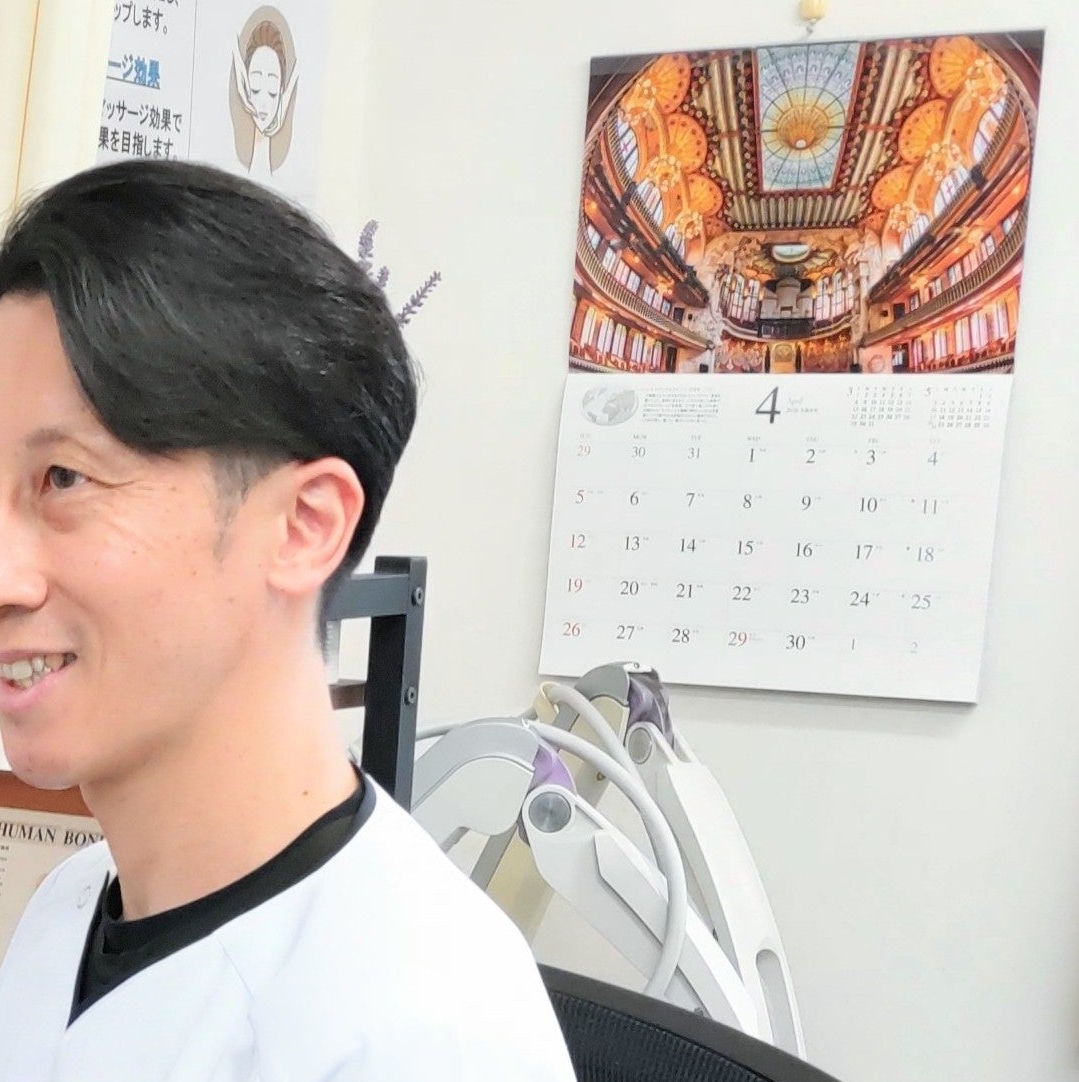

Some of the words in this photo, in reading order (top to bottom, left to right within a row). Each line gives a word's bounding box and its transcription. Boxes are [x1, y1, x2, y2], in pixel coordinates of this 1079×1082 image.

[755, 386, 781, 425] 4
[576, 444, 592, 458] 29
[631, 444, 646, 459] 30
[687, 446, 701, 460] 31
[806, 449, 815, 464] 2
[866, 450, 875, 465] 3
[927, 451, 938, 466] 4
[576, 490, 585, 504] 5
[630, 492, 638, 505] 6
[686, 493, 695, 507] 7
[743, 494, 752, 508] 8
[802, 496, 811, 510] 9
[860, 497, 877, 512] 10
[923, 499, 937, 514] 11
[571, 533, 586, 549] 12
[625, 536, 642, 551] 13
[681, 538, 696, 552] 14
[738, 541, 753, 555] 15
[797, 543, 812, 557] 16
[856, 545, 873, 559] 17
[917, 547, 934, 562] 18
[568, 578, 582, 593] 19
[621, 581, 639, 595] 20
[676, 583, 692, 598] 21
[732, 586, 751, 601] 22
[791, 588, 809, 604] 23
[850, 591, 869, 607] 24
[911, 594, 931, 610] 25
[563, 622, 580, 637] 26
[616, 625, 635, 640] 27
[672, 628, 690, 643] 28
[728, 631, 747, 646] 29
[786, 635, 805, 649] 30
